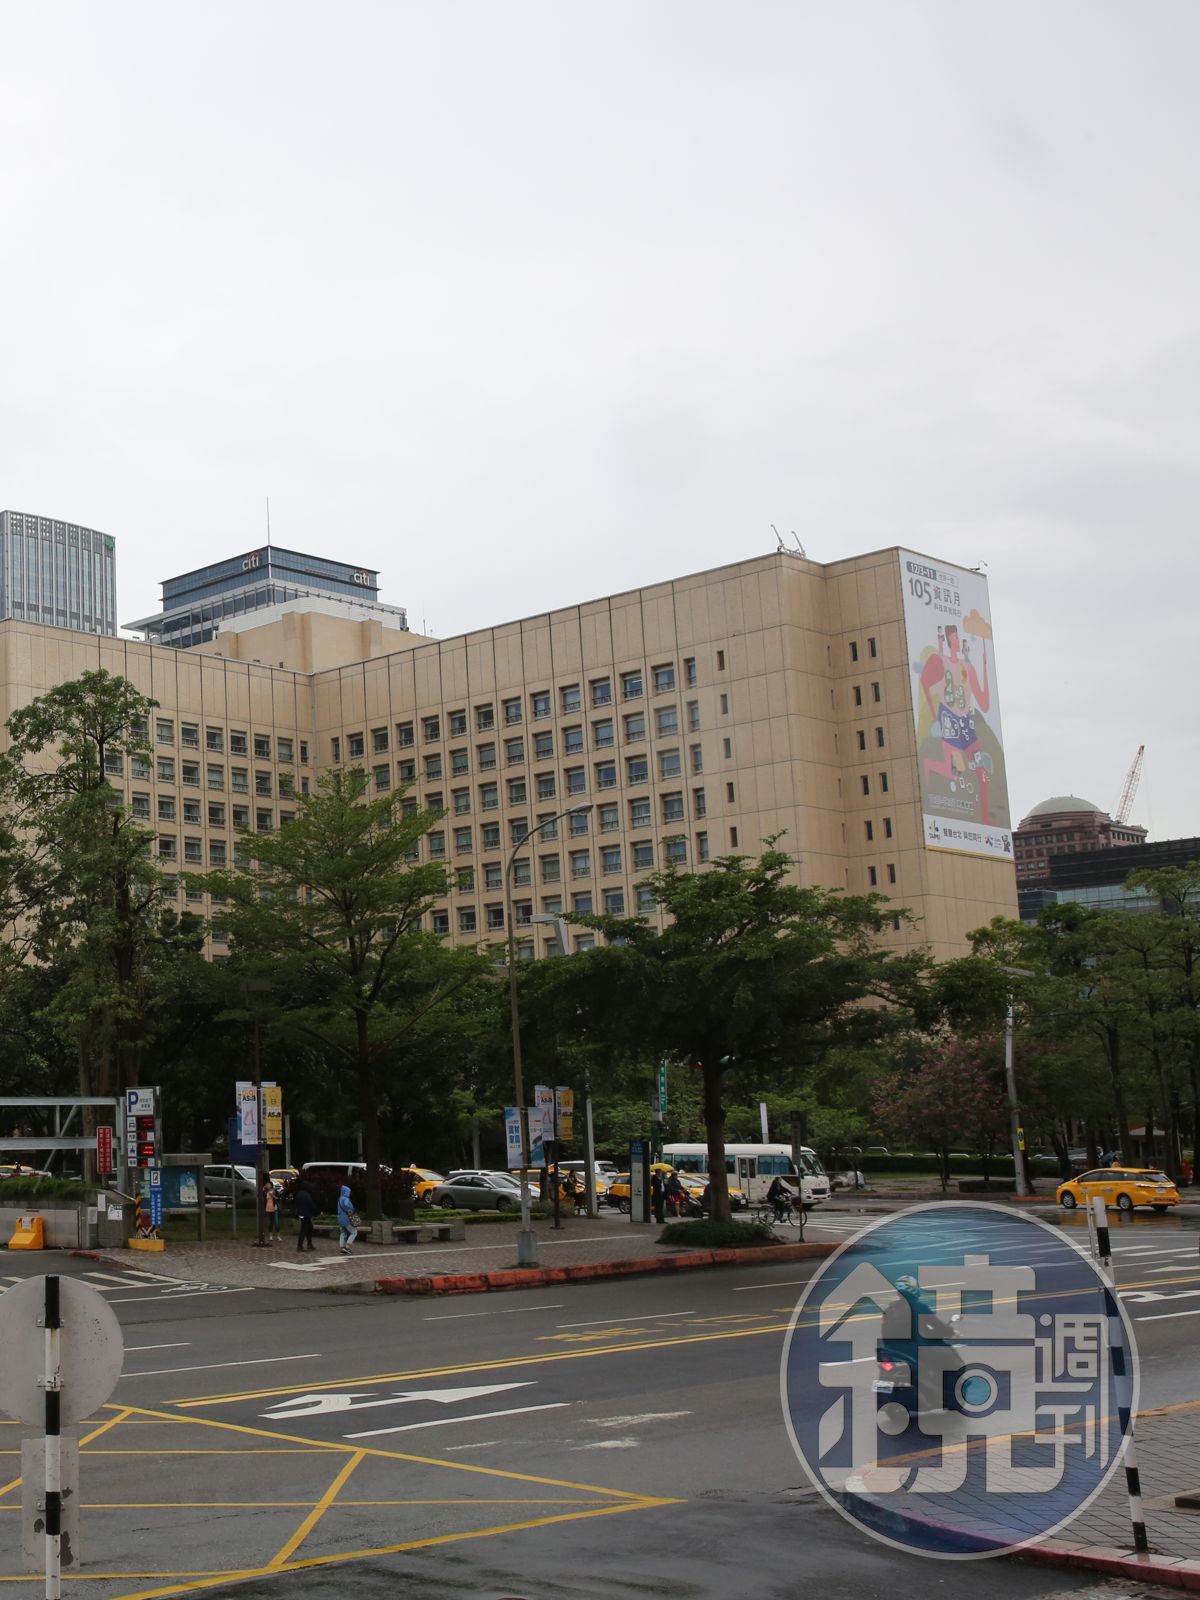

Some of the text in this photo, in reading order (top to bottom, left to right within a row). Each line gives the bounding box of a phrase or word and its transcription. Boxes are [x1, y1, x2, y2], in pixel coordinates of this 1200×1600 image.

[242, 555, 259, 570] citi
[353, 571, 370, 586] citi
[128, 1092, 138, 1113] P
